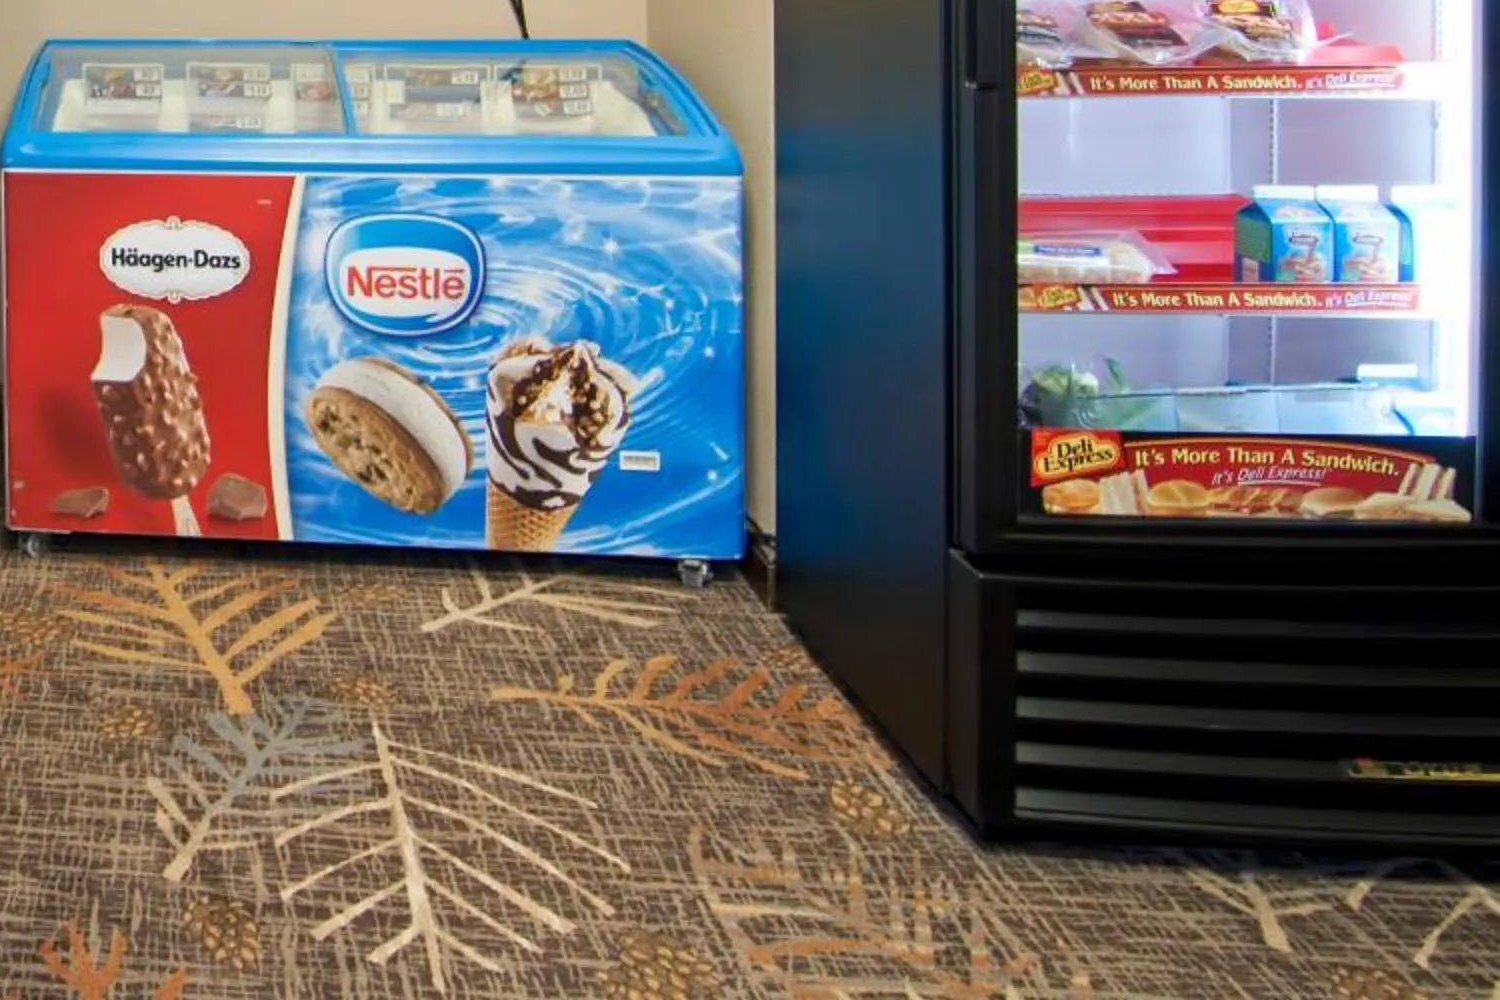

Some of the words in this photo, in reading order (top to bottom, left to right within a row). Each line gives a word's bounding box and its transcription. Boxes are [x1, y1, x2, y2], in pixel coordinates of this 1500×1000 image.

[1090, 76, 1115, 90] It's
[1119, 76, 1157, 90] More
[1162, 76, 1201, 89] Than
[1207, 76, 1218, 89] A
[111, 248, 241, 272] Häagen-Dazs
[347, 265, 465, 299] Nestlé
[1112, 292, 1137, 306] It's
[1142, 292, 1181, 306] More
[1185, 292, 1223, 306] Than
[1229, 292, 1240, 306] A
[1057, 439, 1093, 457] Deli
[1043, 449, 1113, 472] Express
[1135, 450, 1164, 466] It's
[1172, 448, 1220, 463] More
[1227, 447, 1274, 463] Than
[1281, 448, 1295, 464] A
[1302, 449, 1399, 476] Sandwich.
[1237, 466, 1264, 482] Deli
[1268, 465, 1327, 482] Express!
